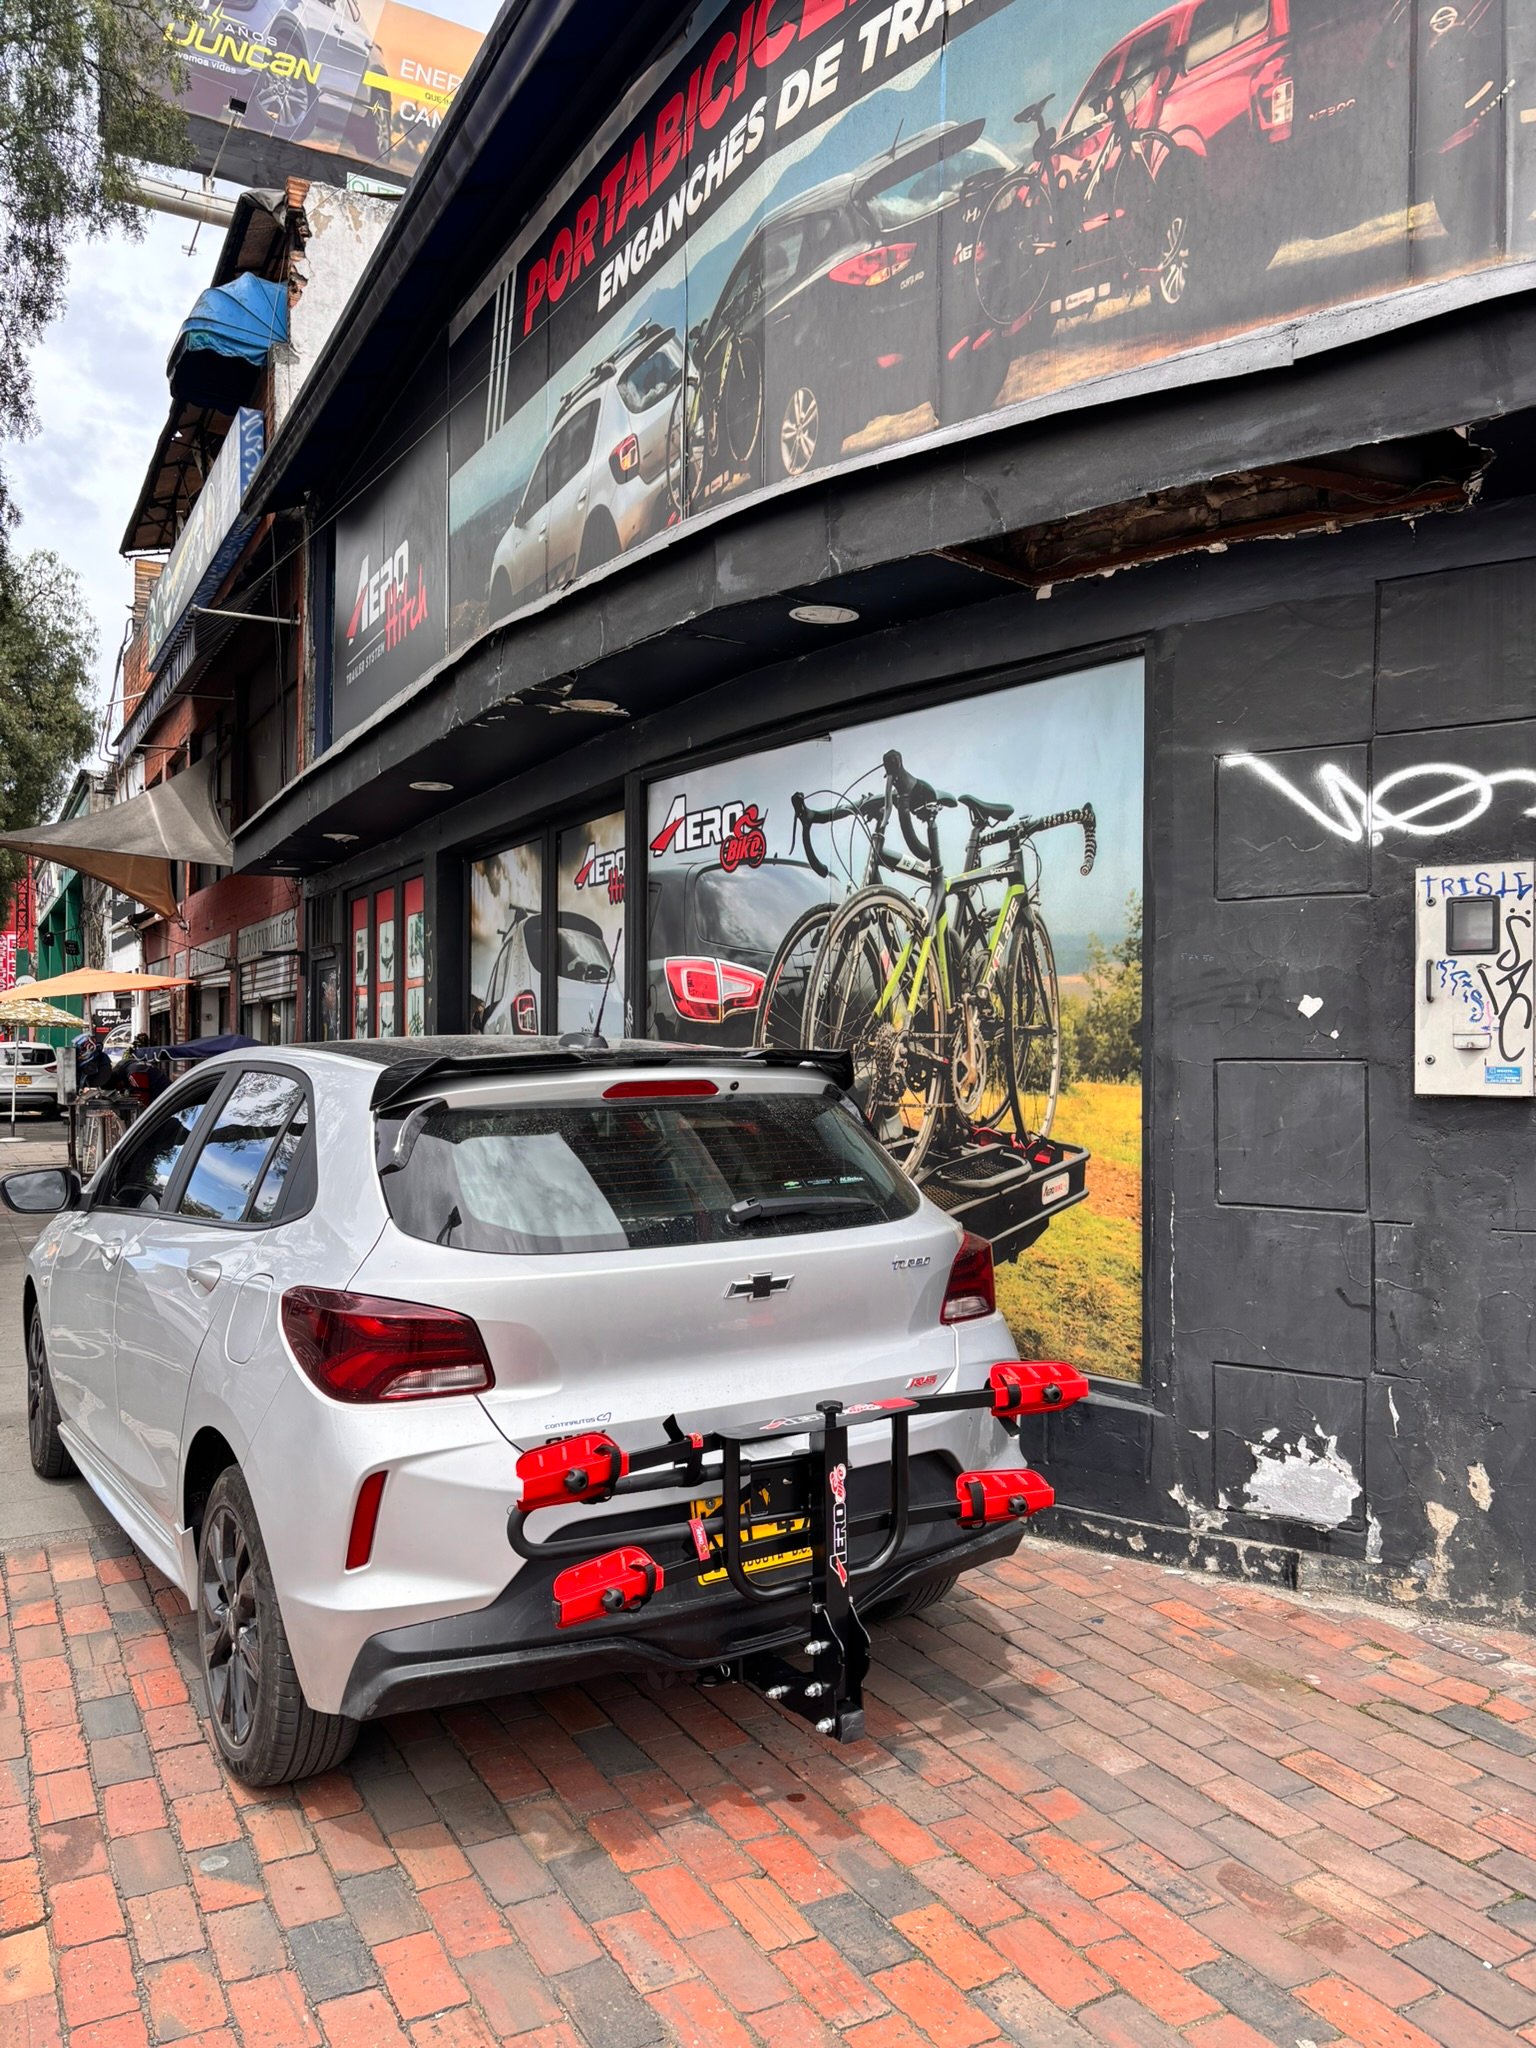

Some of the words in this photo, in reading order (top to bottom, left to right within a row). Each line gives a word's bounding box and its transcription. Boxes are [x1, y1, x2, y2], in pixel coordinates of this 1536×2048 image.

[224, 23, 278, 47] AÑOS
[597, 96, 767, 312] ENGANCHES
[775, 38, 845, 131] DE
[858, 0, 975, 75] TRA
[650, 793, 745, 858] AERO
[829, 1502, 848, 1588] AERO
